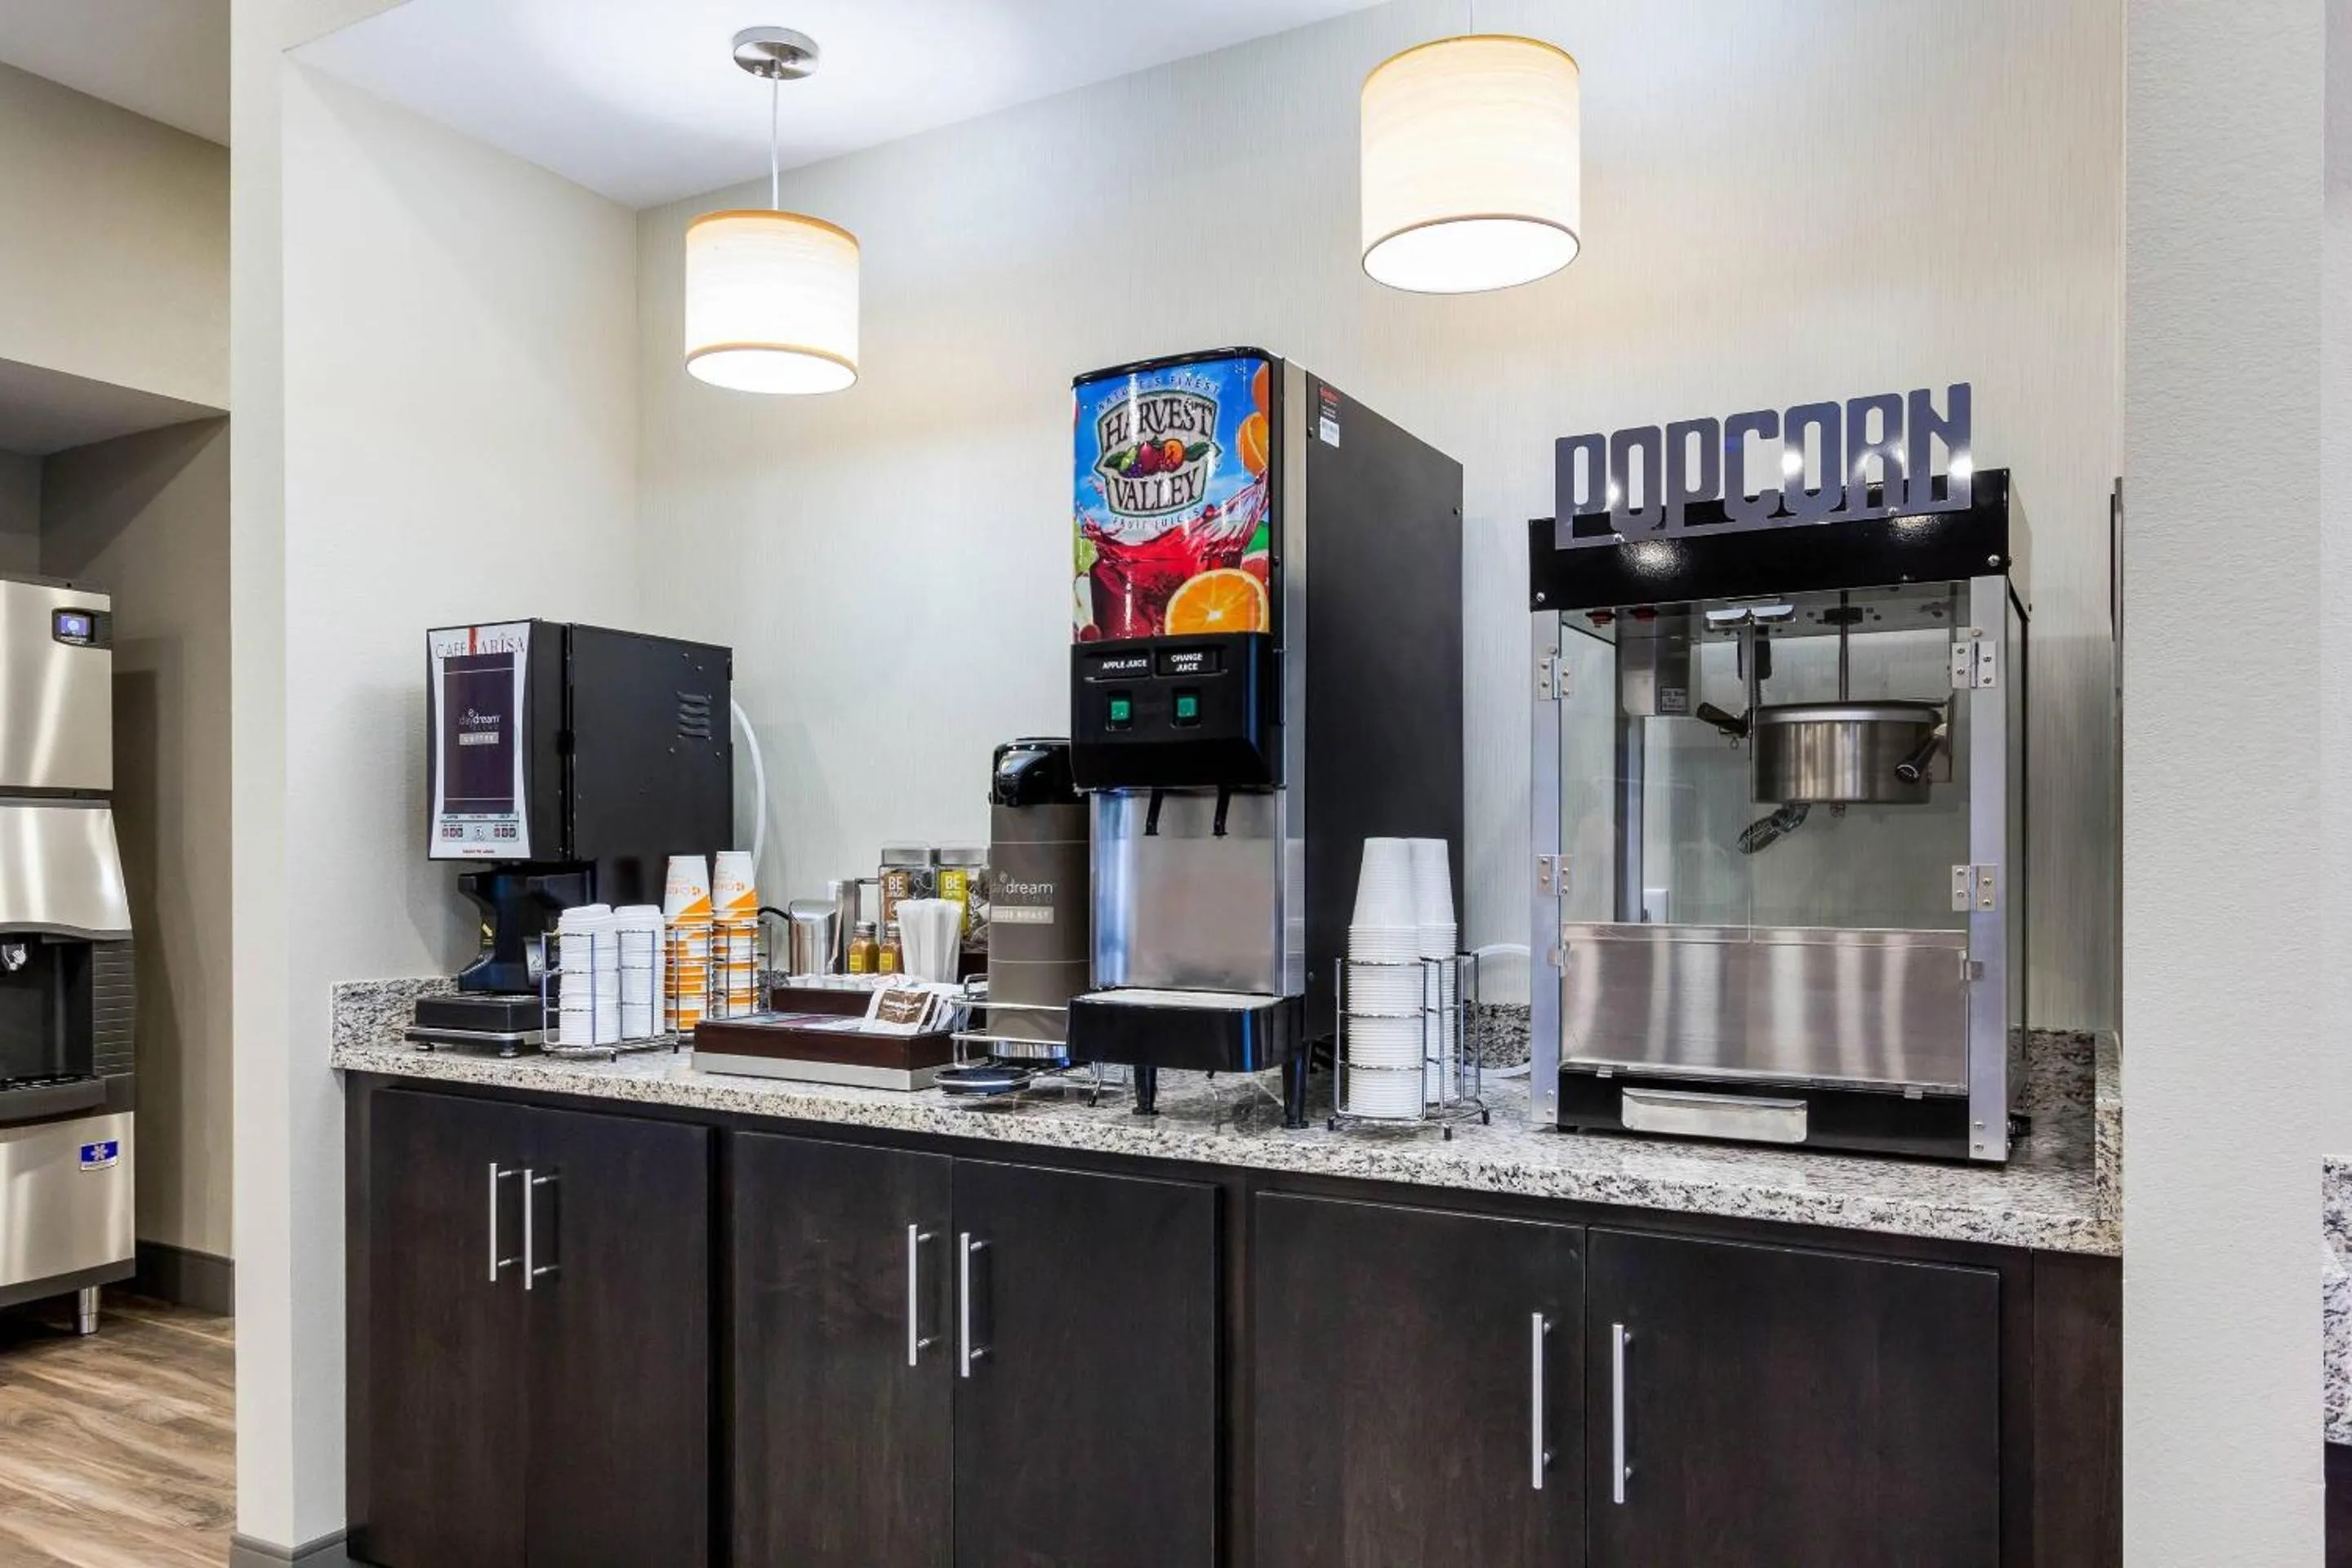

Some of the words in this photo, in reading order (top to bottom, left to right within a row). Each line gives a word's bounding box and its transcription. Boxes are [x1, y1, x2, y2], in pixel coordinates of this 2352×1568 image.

[1169, 374, 1220, 395] FINEST
[1555, 382, 1971, 550] POPCORN
[1112, 466, 1200, 512] VALLEY
[1102, 660, 1125, 670] APPLE
[1126, 658, 1147, 668] JUICE
[1171, 653, 1203, 663] ORANGE
[1176, 662, 1198, 671] JUICE
[888, 875, 904, 890] BE
[945, 875, 960, 889] BE
